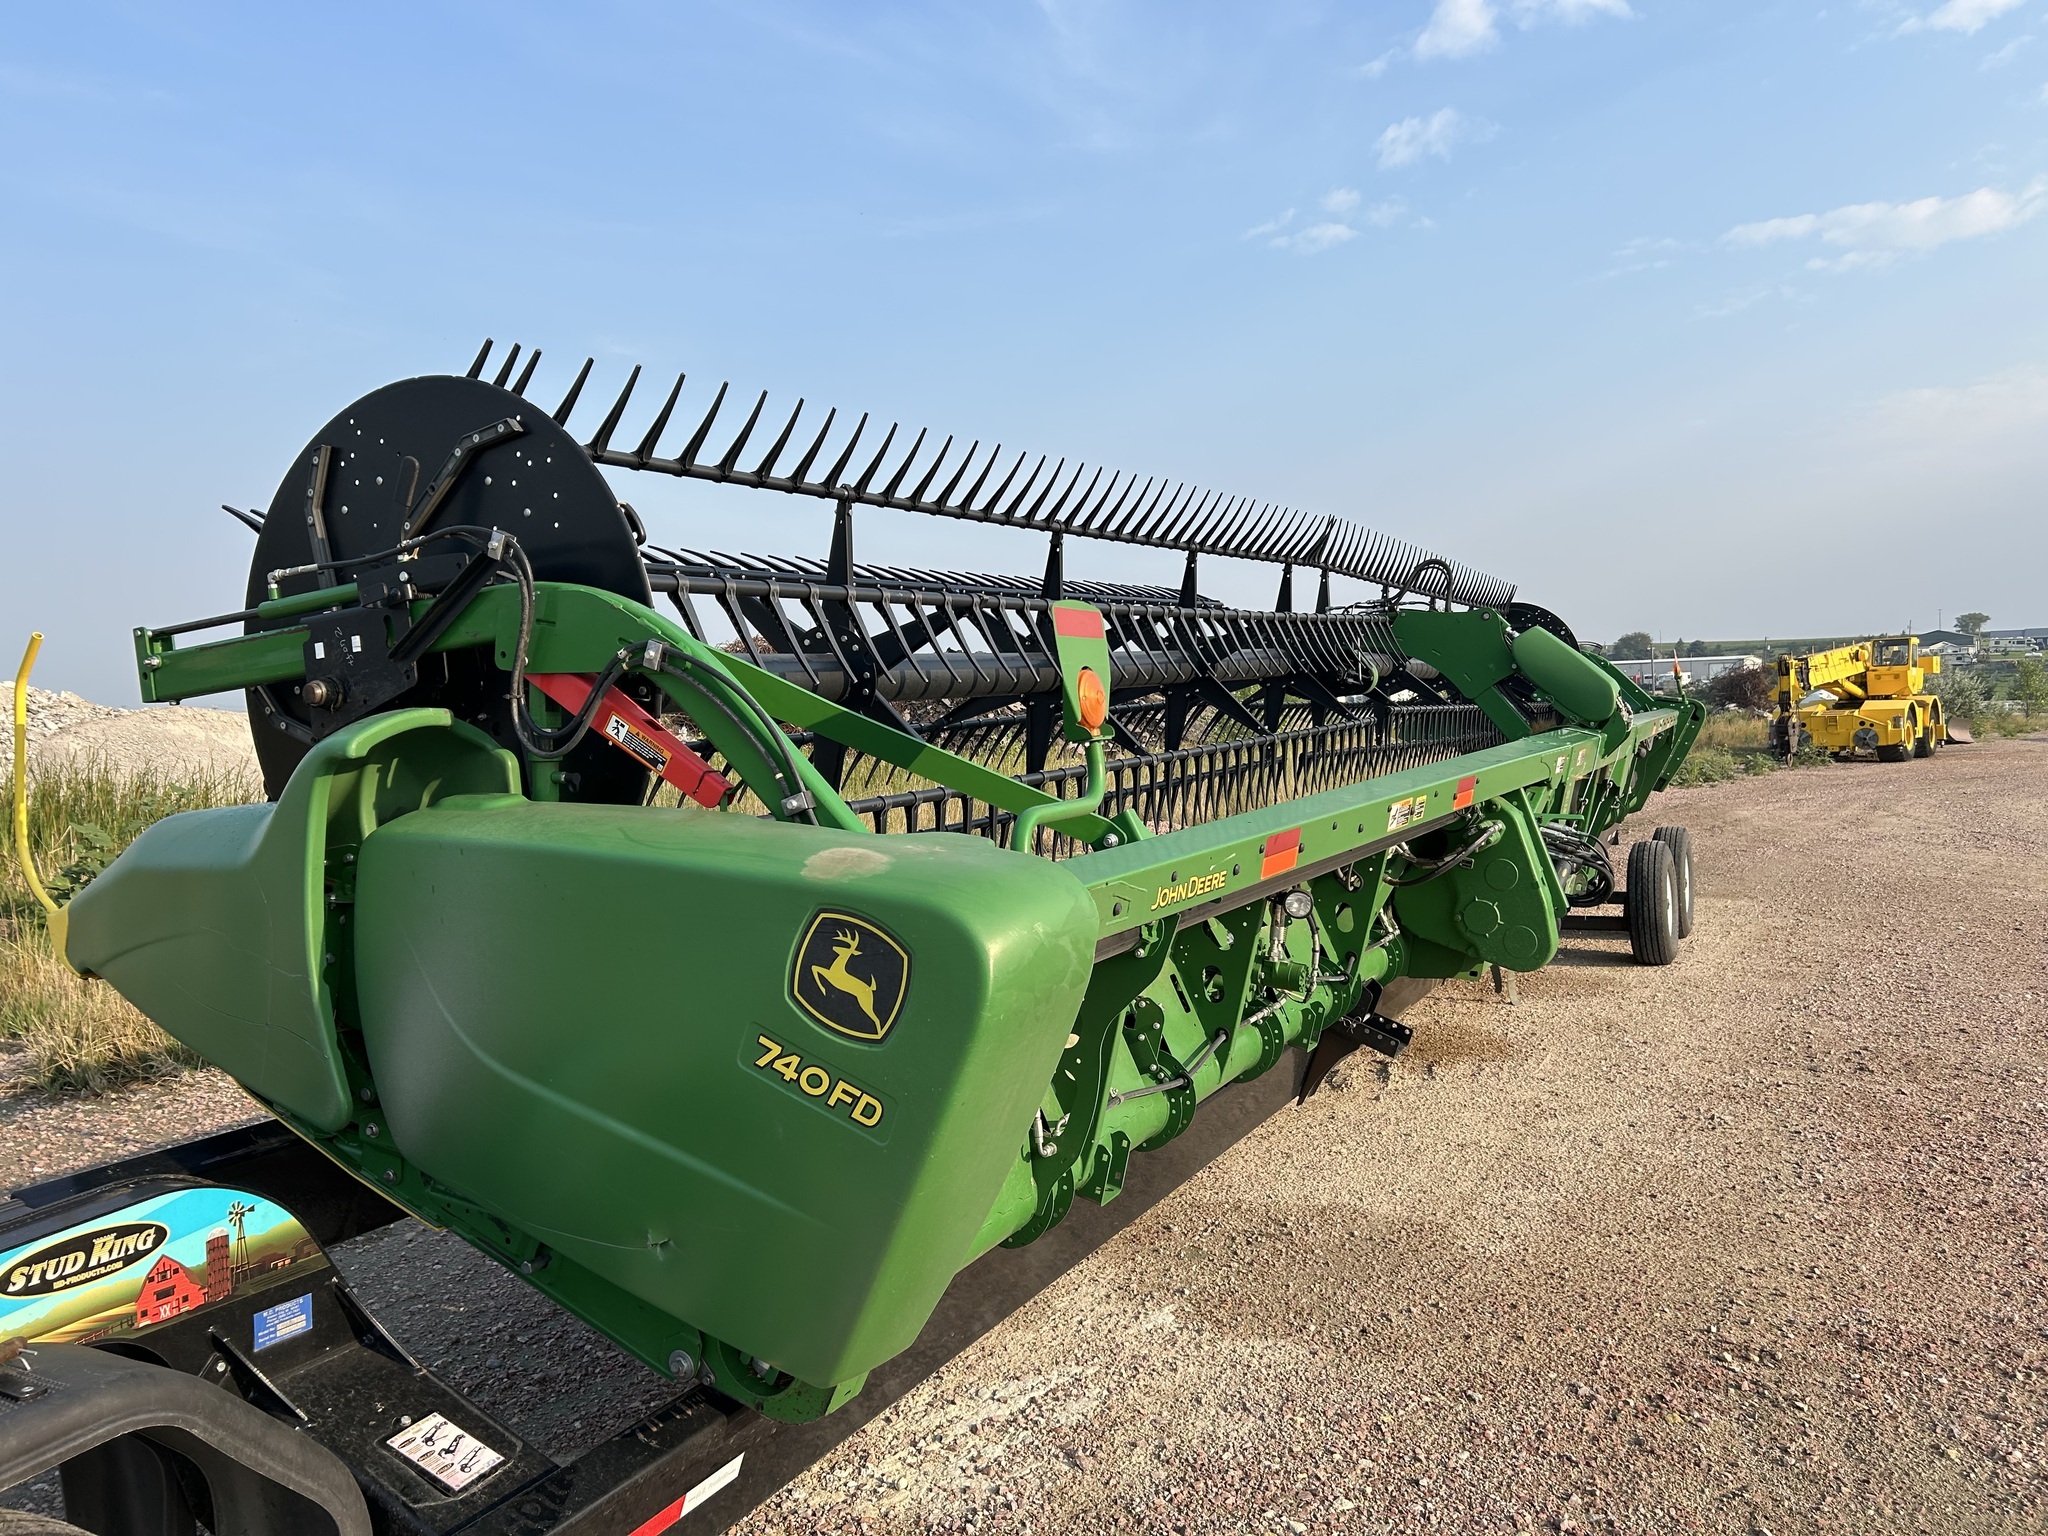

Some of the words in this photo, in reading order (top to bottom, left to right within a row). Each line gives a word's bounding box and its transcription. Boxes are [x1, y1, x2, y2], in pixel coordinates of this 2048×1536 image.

[641, 734, 665, 755] WARNING
[1150, 882, 1188, 911] JOHN
[1187, 870, 1228, 898] DEERE
[754, 1033, 885, 1128] 740FD
[6, 1250, 87, 1293] STUD
[88, 1227, 156, 1268] KING
